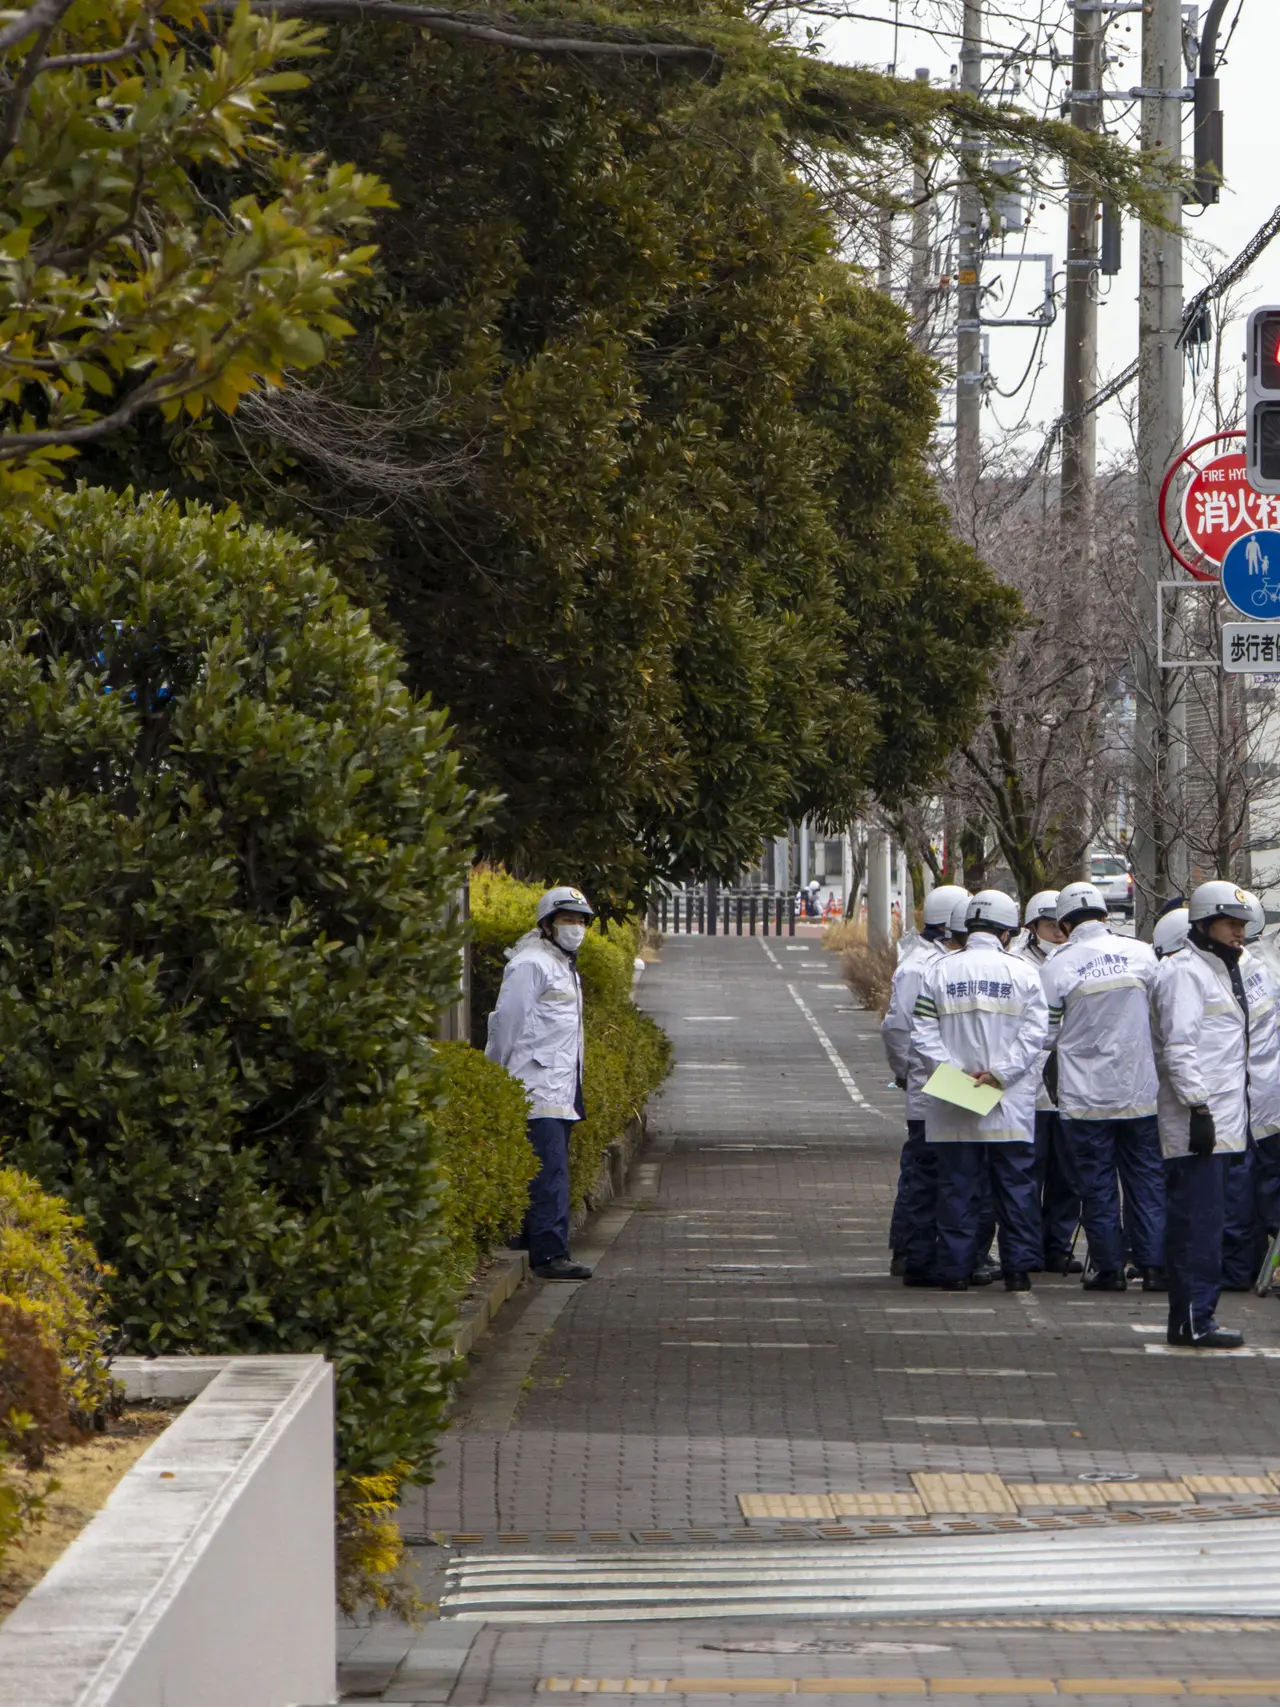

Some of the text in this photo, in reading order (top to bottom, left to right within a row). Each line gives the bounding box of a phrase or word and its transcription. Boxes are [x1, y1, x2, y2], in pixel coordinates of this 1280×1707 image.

[1202, 469, 1225, 482] FIRE
[1084, 963, 1129, 980] POLICE
[946, 979, 1012, 1000] 神奈川県警察
